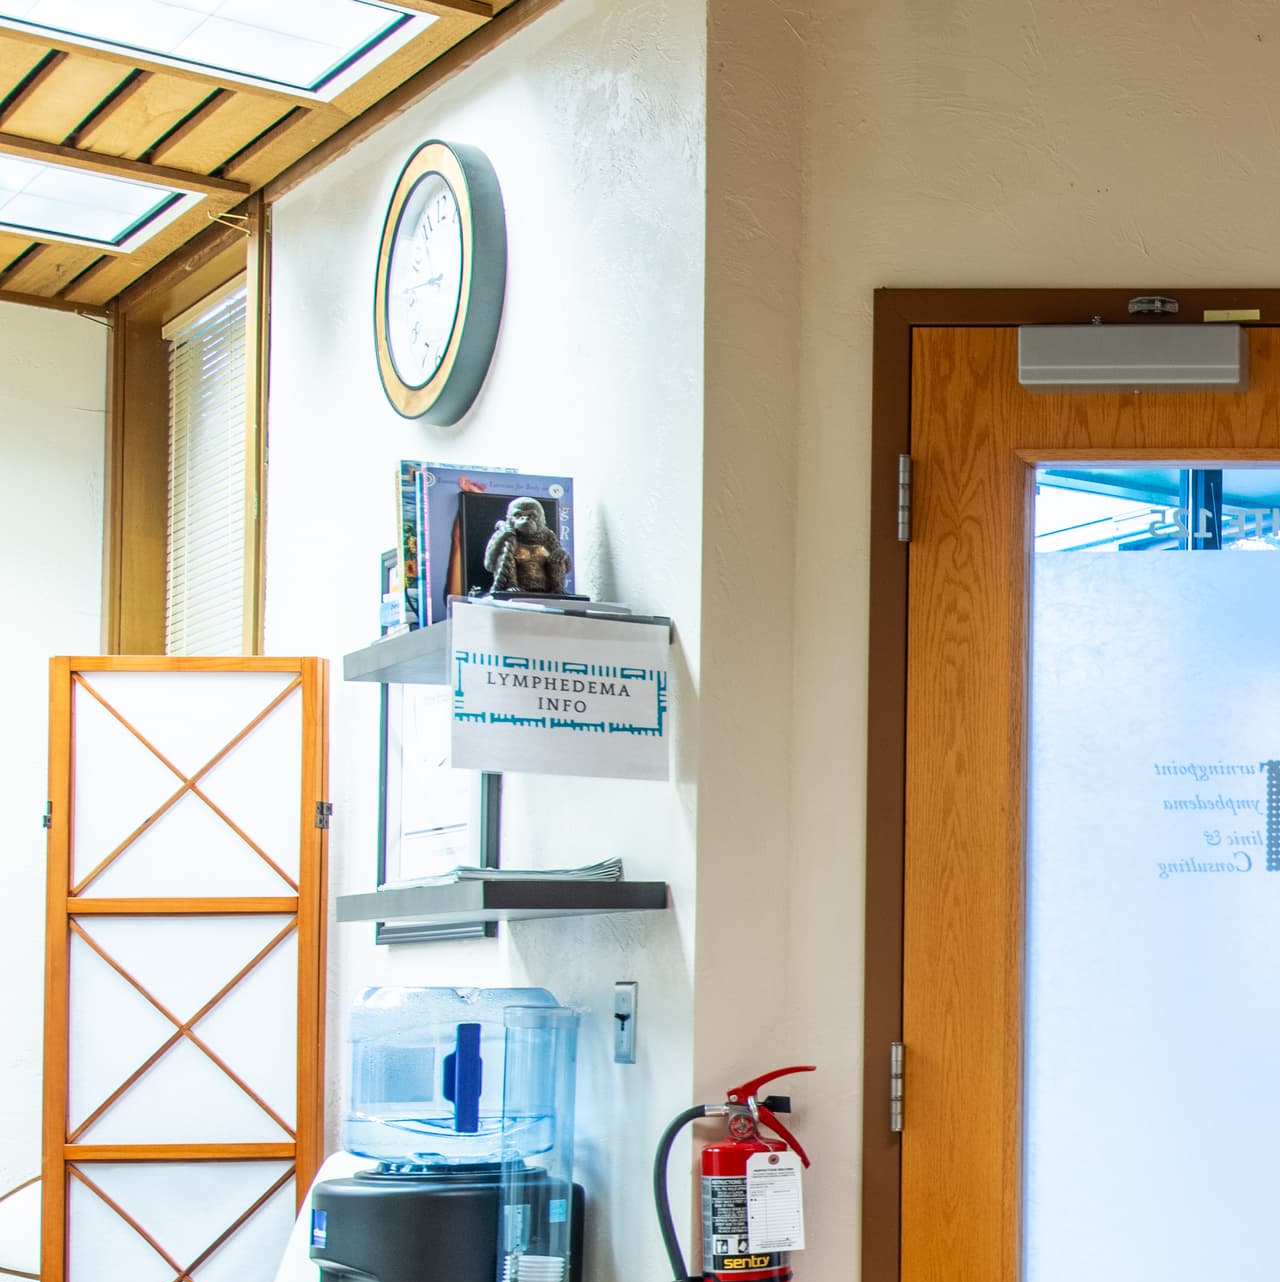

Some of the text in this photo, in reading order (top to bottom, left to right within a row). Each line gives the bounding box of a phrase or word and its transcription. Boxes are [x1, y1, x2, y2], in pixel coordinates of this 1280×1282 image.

[436, 194, 448, 224] 12
[422, 215, 433, 241] 11
[487, 671, 631, 698] LYMPHEDEMA
[538, 697, 587, 714] INFO
[723, 1255, 770, 1270] sentry
